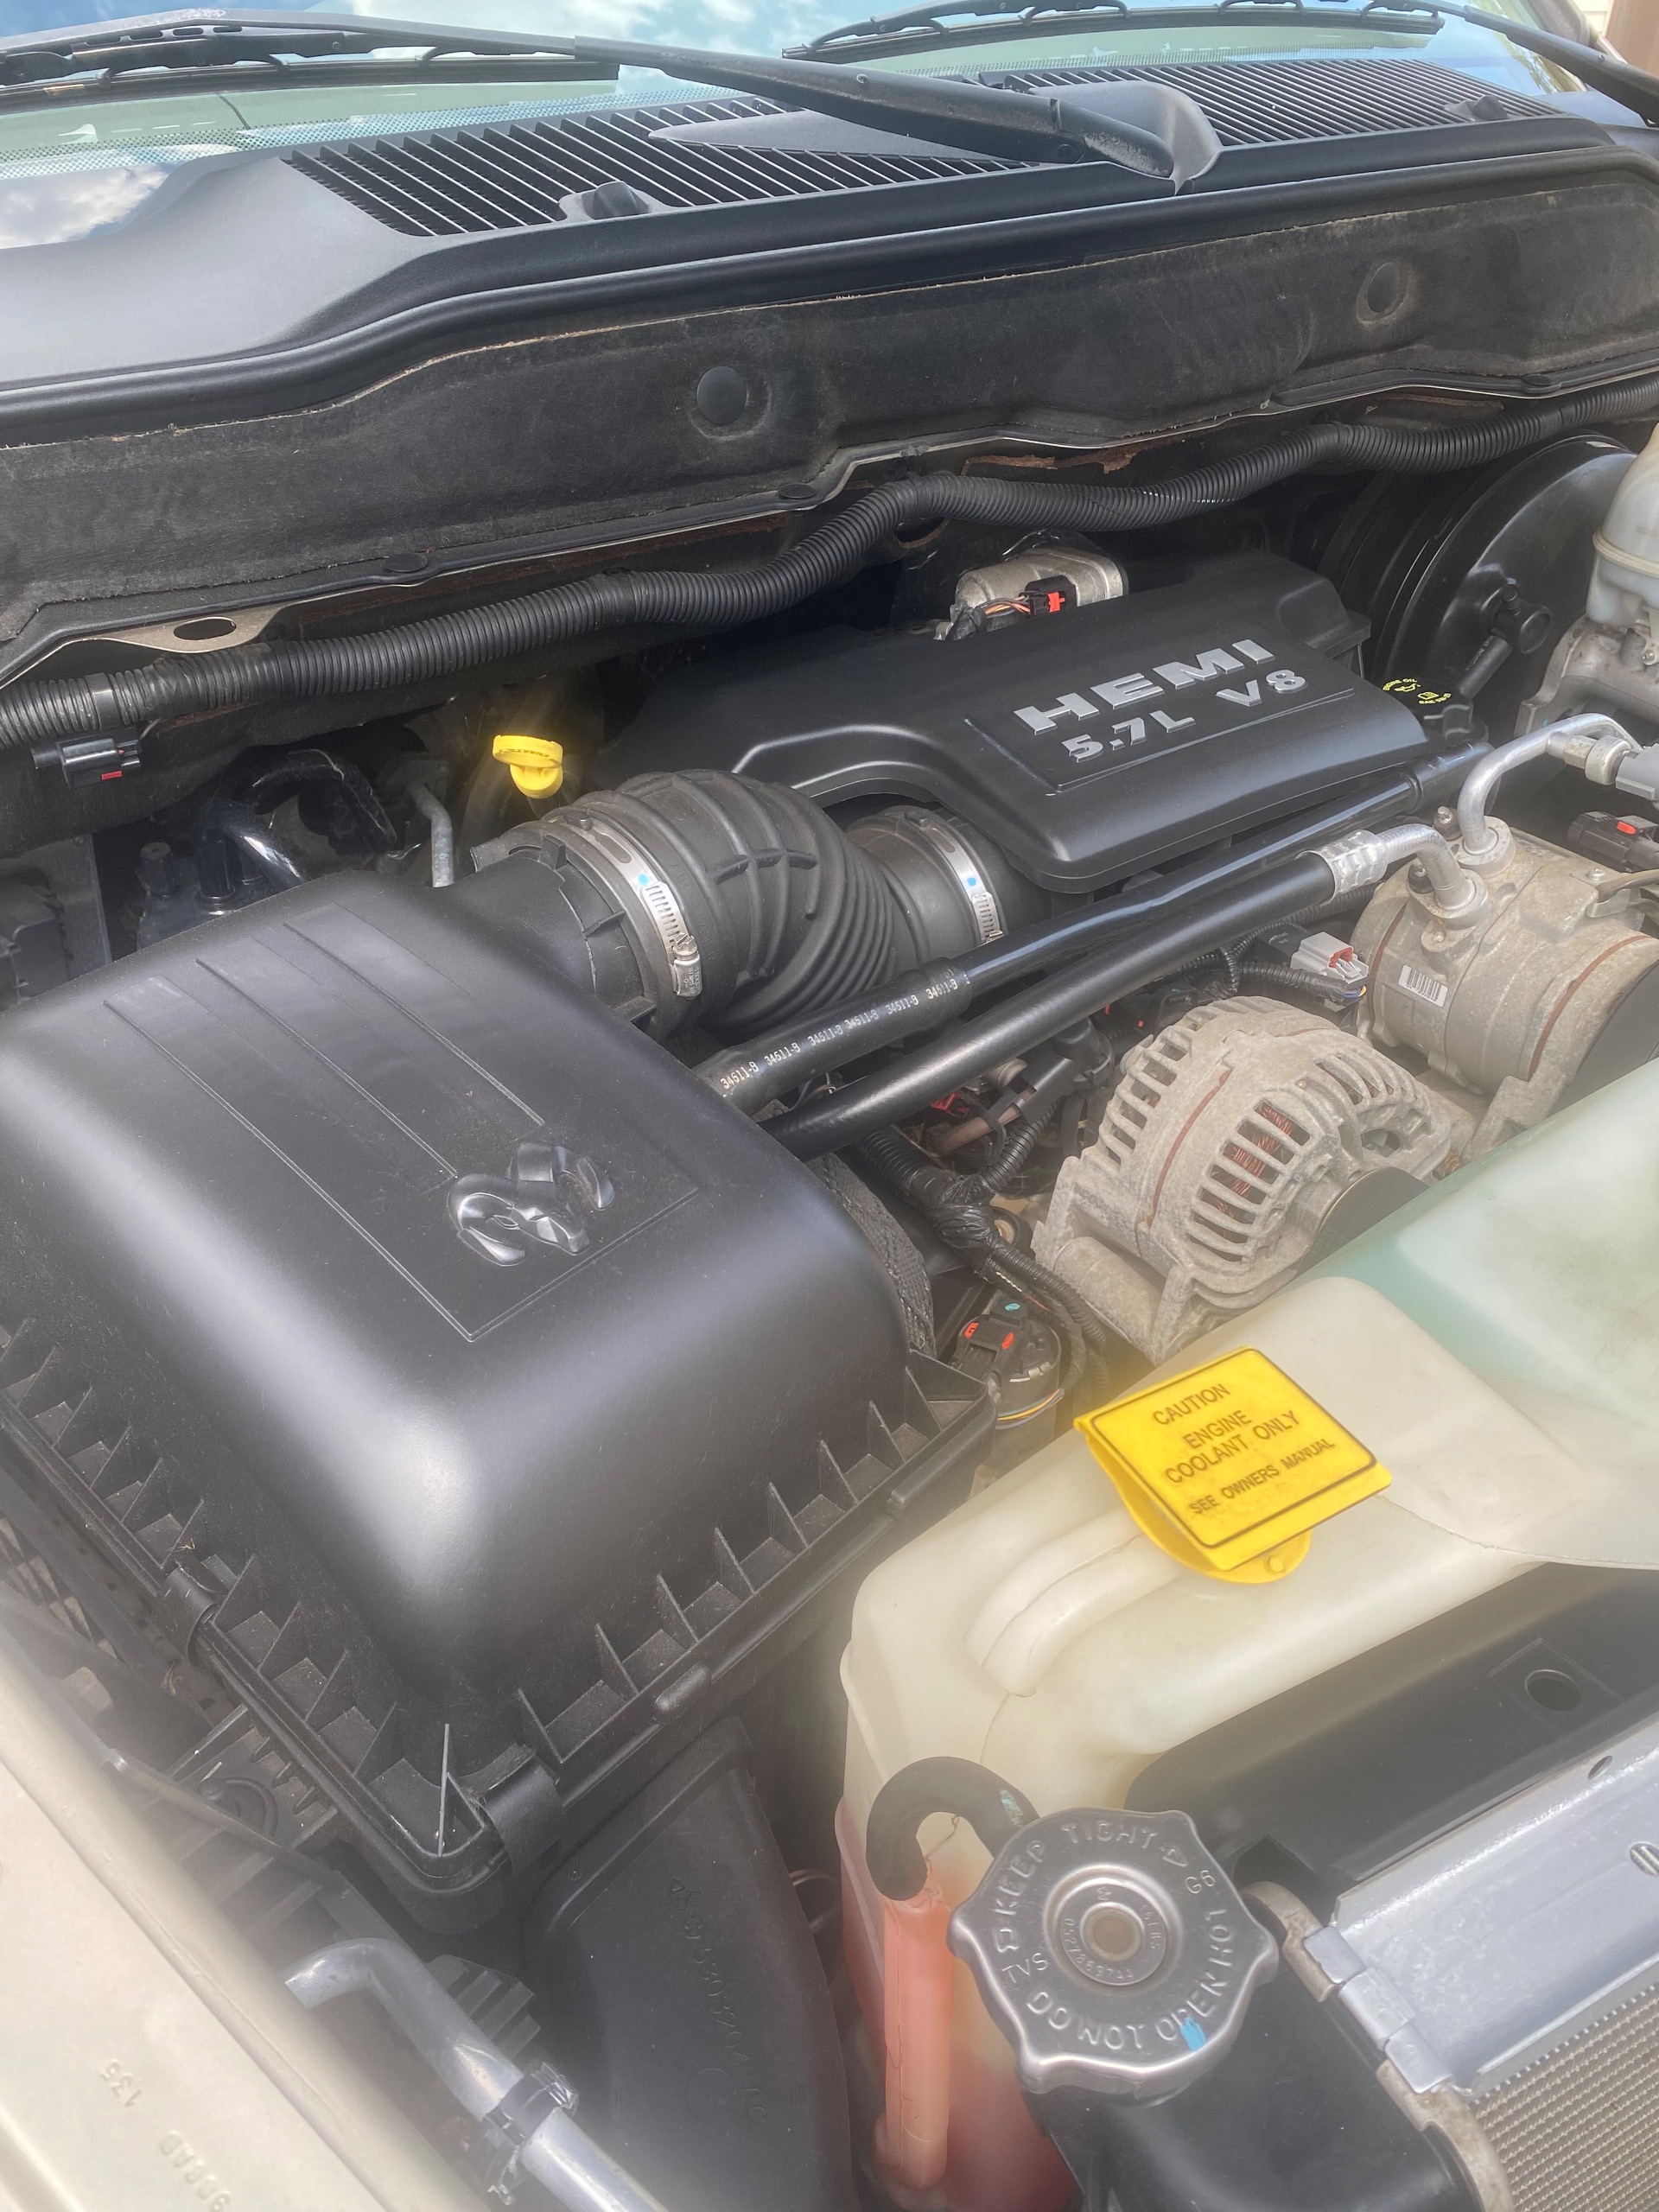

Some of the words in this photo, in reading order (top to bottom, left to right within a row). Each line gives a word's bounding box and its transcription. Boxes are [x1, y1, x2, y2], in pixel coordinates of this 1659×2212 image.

[1014, 639, 1275, 735] HEMI
[1062, 709, 1196, 763] 5.7L
[1215, 669, 1308, 707] V8
[720, 1061, 760, 1090] 34611-B
[764, 1041, 802, 1066] 34611-B
[808, 1024, 844, 1046] 34611-B
[844, 1009, 880, 1030] 34611-B
[886, 994, 919, 1015] 34611-B
[925, 978, 959, 1000] 34611-B
[1153, 1383, 1230, 1425] CAUTION
[1183, 1409, 1252, 1450] ENGINE
[1165, 1433, 1250, 1484] COOLANT
[1253, 1410, 1300, 1440] ONLY
[1190, 1494, 1218, 1515] SEE
[1221, 1465, 1280, 1499] OWNERS
[1281, 1438, 1336, 1470] MANUAL
[994, 1840, 1047, 1916] KEEP
[1060, 1819, 1160, 1849] TIGHT
[1001, 1952, 1049, 1985] TVS
[1026, 1990, 1072, 2031] DO
[1077, 2024, 1147, 2050] NOT
[1155, 1971, 1228, 2042] OPEN
[1205, 1909, 1233, 1967] HOT
[100, 2059, 143, 2108] 135
